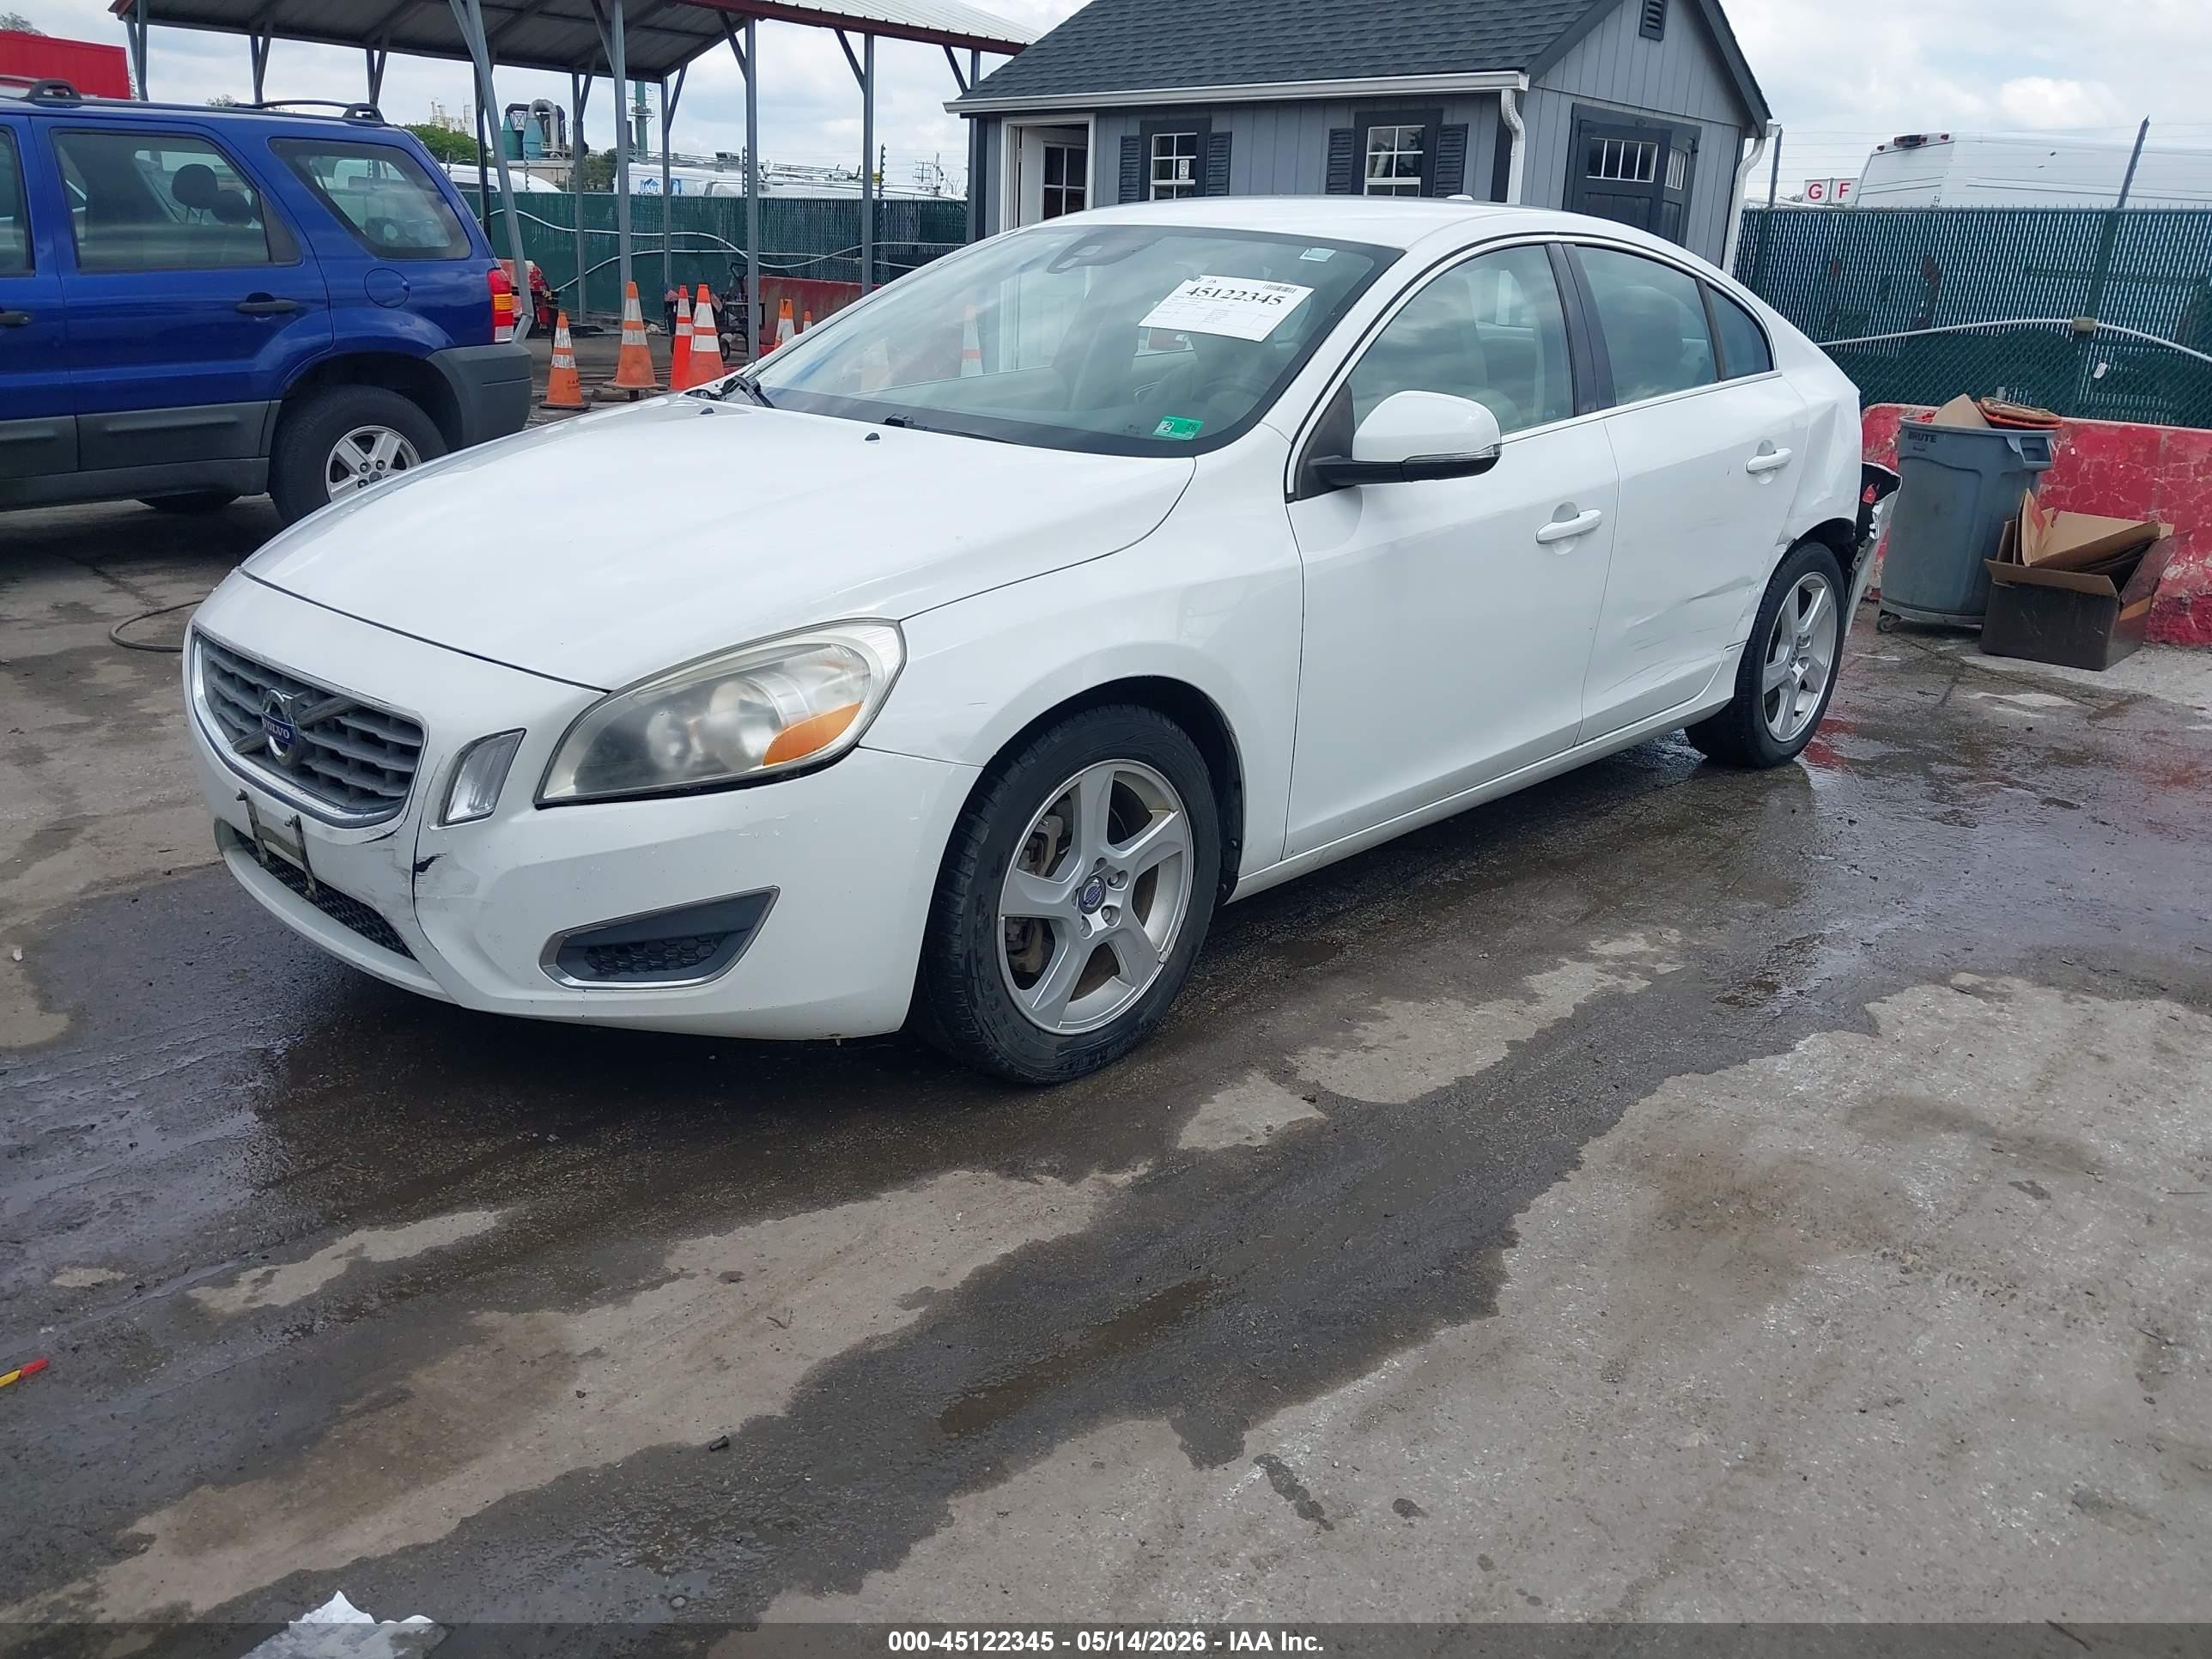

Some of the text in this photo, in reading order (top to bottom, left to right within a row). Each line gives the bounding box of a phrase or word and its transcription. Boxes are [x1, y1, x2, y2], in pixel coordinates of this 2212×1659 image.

[1808, 183, 1822, 199] G
[1838, 183, 1850, 198] F
[1185, 287, 1286, 306] 45122345
[1164, 422, 1173, 431] 2
[1908, 431, 1937, 443] BRUTE
[261, 716, 290, 739] VOLVO
